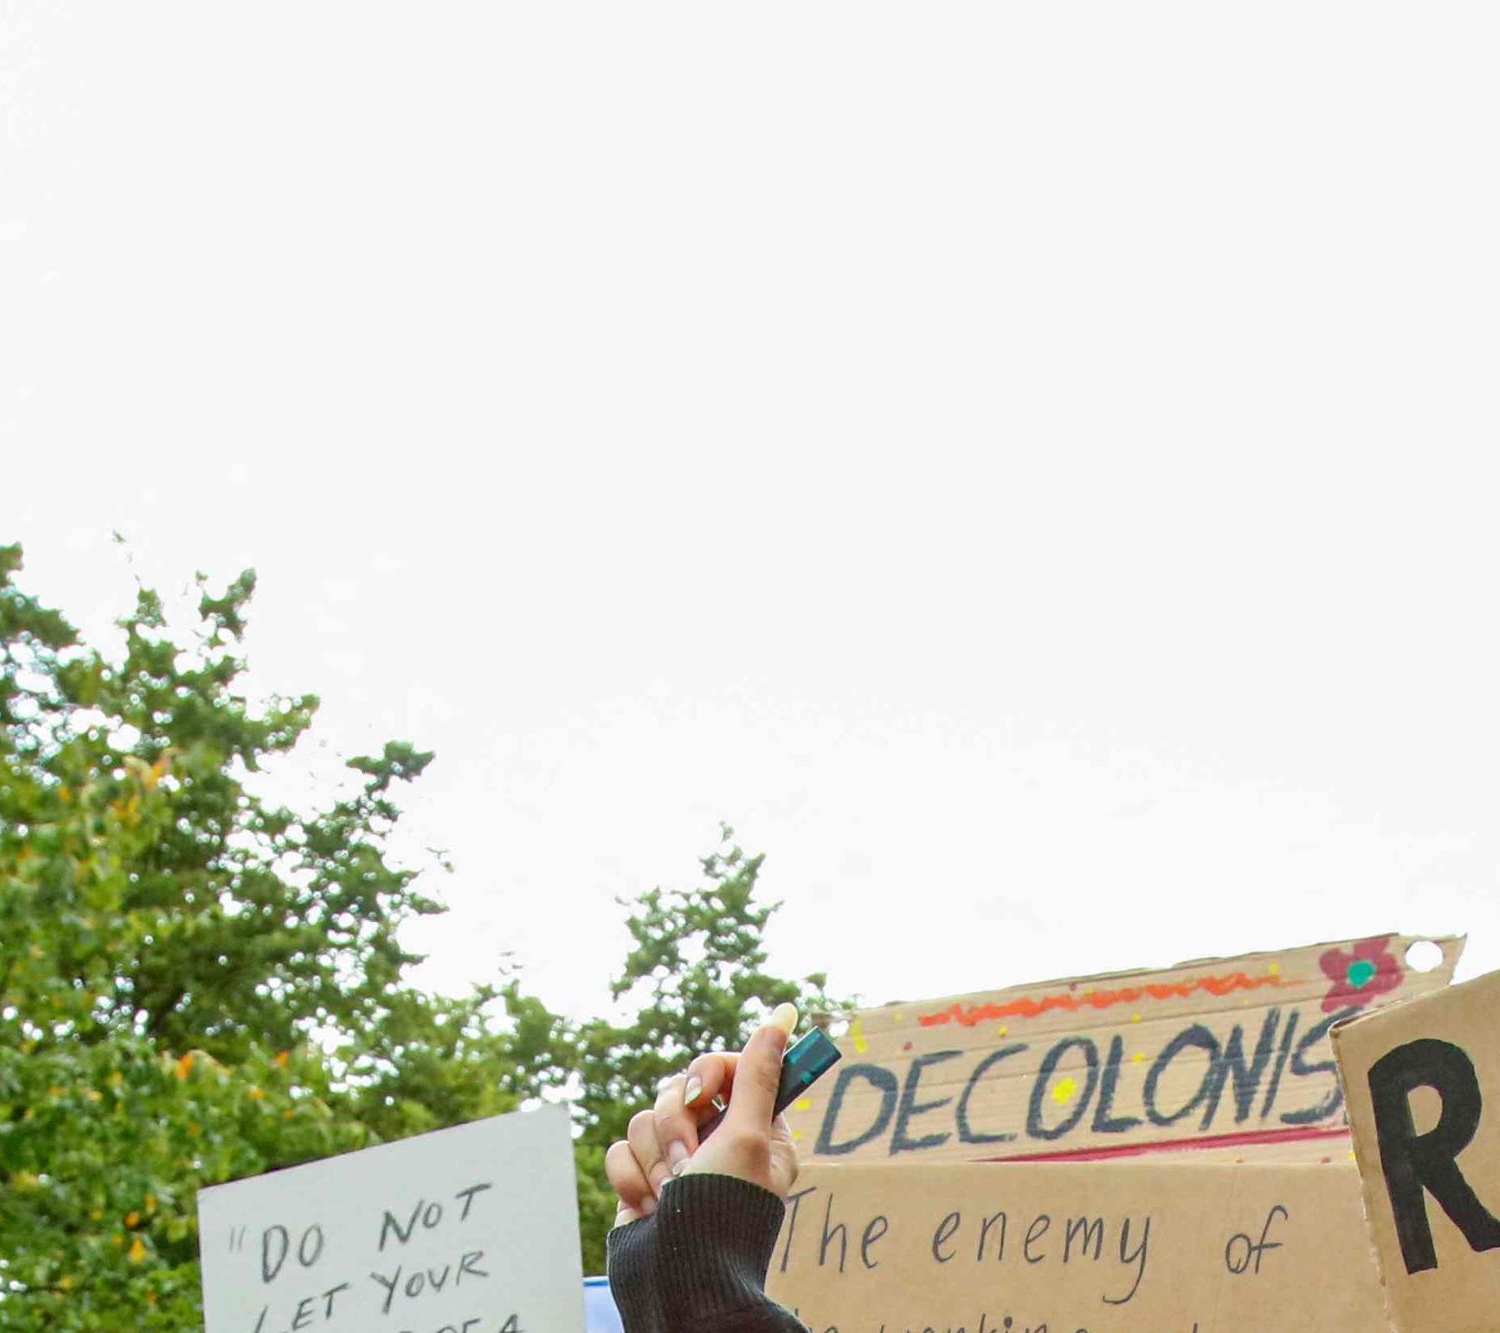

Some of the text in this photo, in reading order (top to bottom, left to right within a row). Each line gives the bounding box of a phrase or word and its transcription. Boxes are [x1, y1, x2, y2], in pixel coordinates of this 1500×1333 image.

[815, 1006, 1363, 1156] DECOLONIS
[378, 1184, 492, 1250] NOT
[780, 1186, 1289, 1305] The enemy of
[370, 1250, 490, 1314] YOUR
